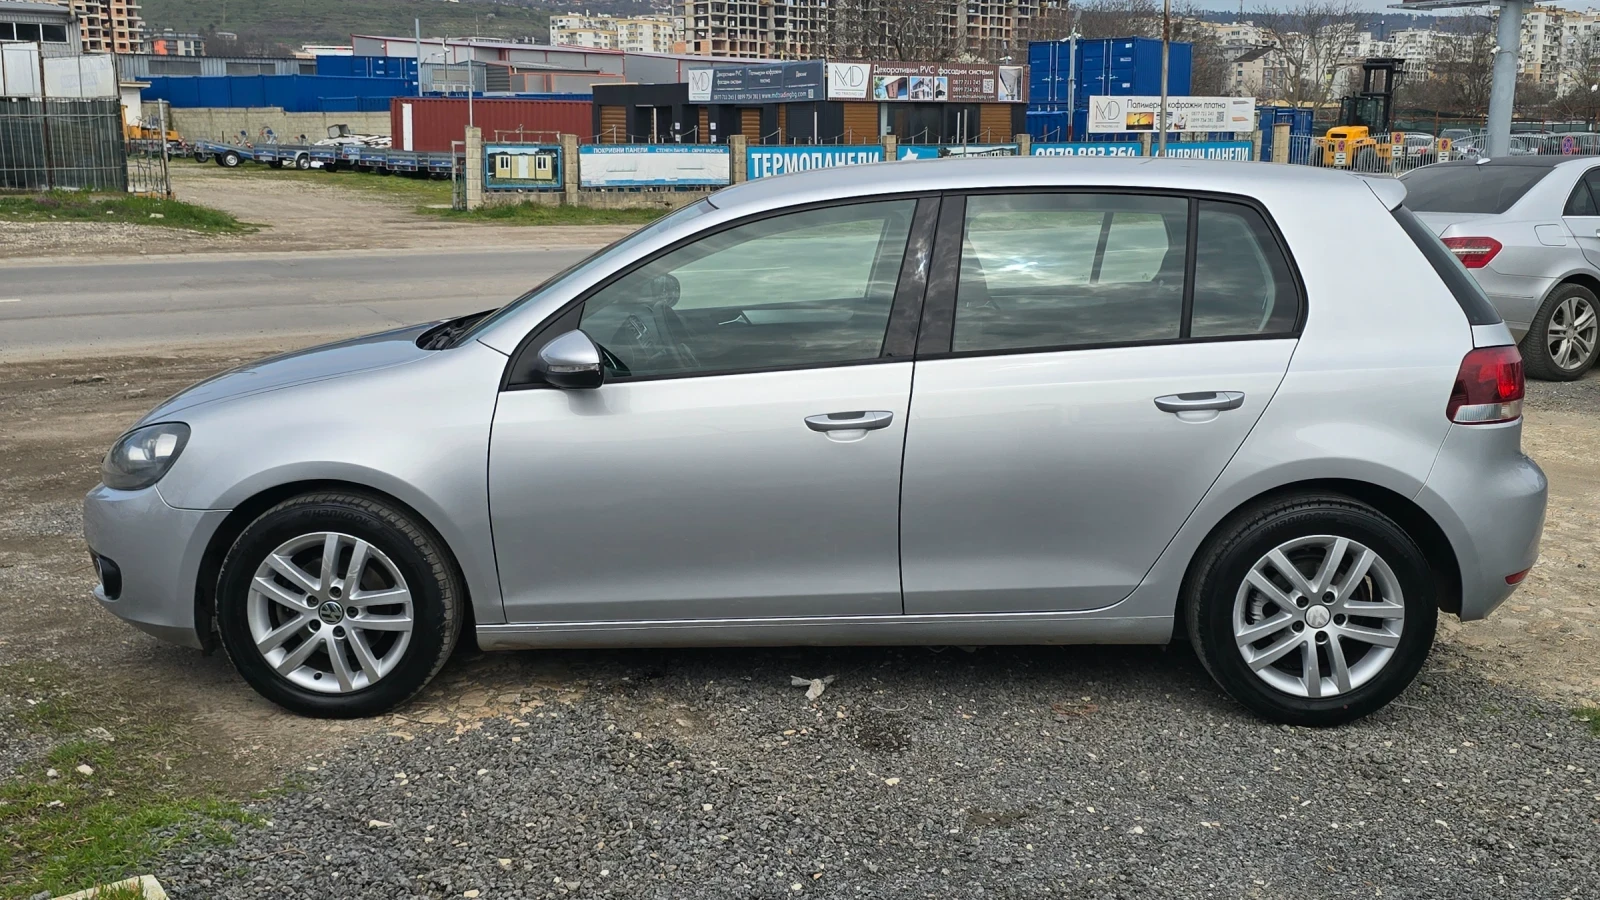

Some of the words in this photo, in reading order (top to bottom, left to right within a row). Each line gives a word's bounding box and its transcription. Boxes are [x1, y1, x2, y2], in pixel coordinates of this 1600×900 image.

[835, 65, 864, 87] MD
[873, 64, 918, 74] Декоративни
[920, 66, 934, 74] PVC
[938, 66, 967, 77] фасадни
[1096, 101, 1120, 120] MD
[1127, 99, 1162, 111] Полимерн
[1168, 99, 1202, 111] кофражни
[1208, 148, 1249, 161] ПАНЕЛИ
